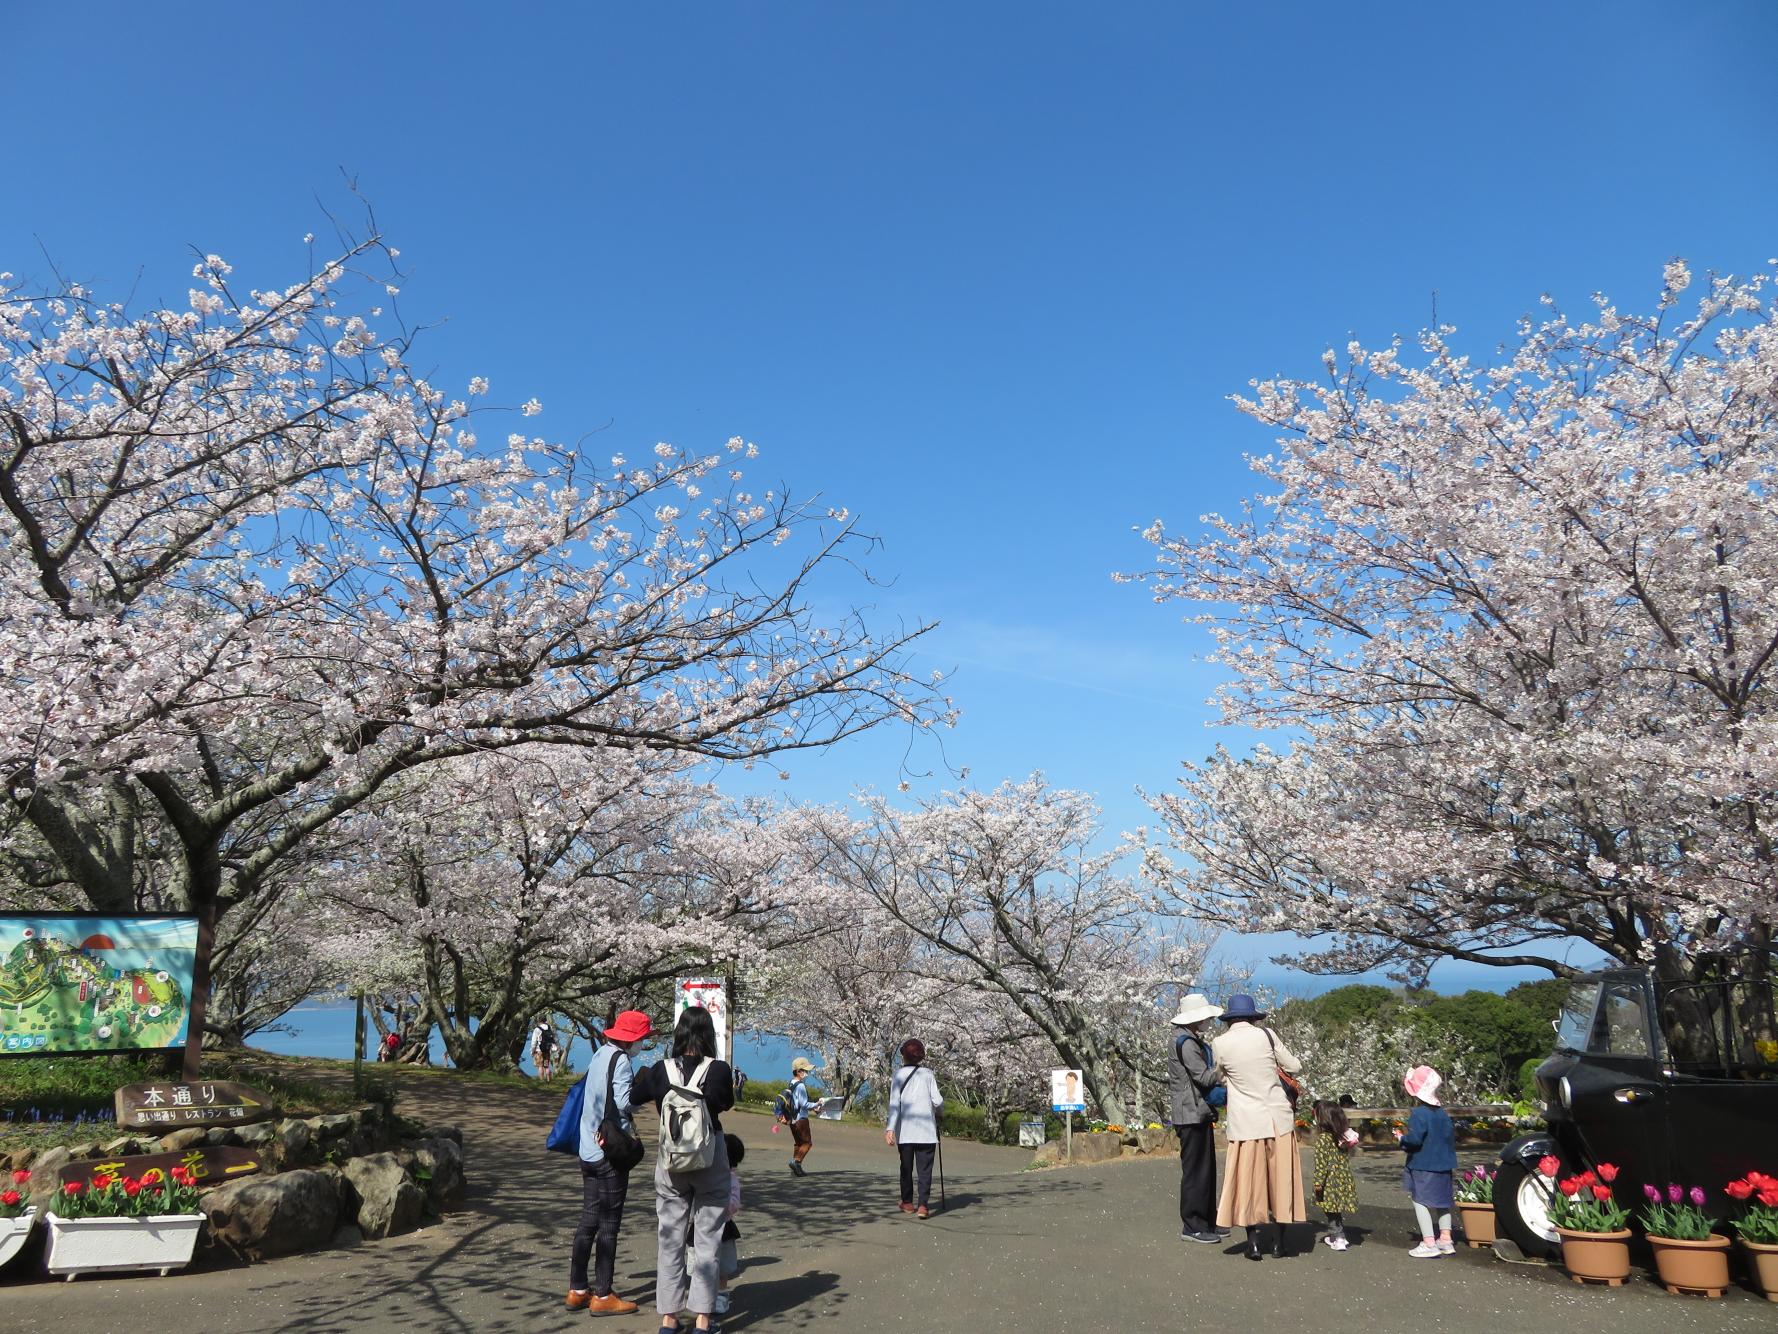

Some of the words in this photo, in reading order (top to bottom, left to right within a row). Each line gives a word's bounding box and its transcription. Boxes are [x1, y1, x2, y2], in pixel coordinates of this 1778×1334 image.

[143, 1085, 216, 1107] 本通り
[137, 1111, 176, 1123] 思い出通り
[185, 1109, 222, 1120] レストラン
